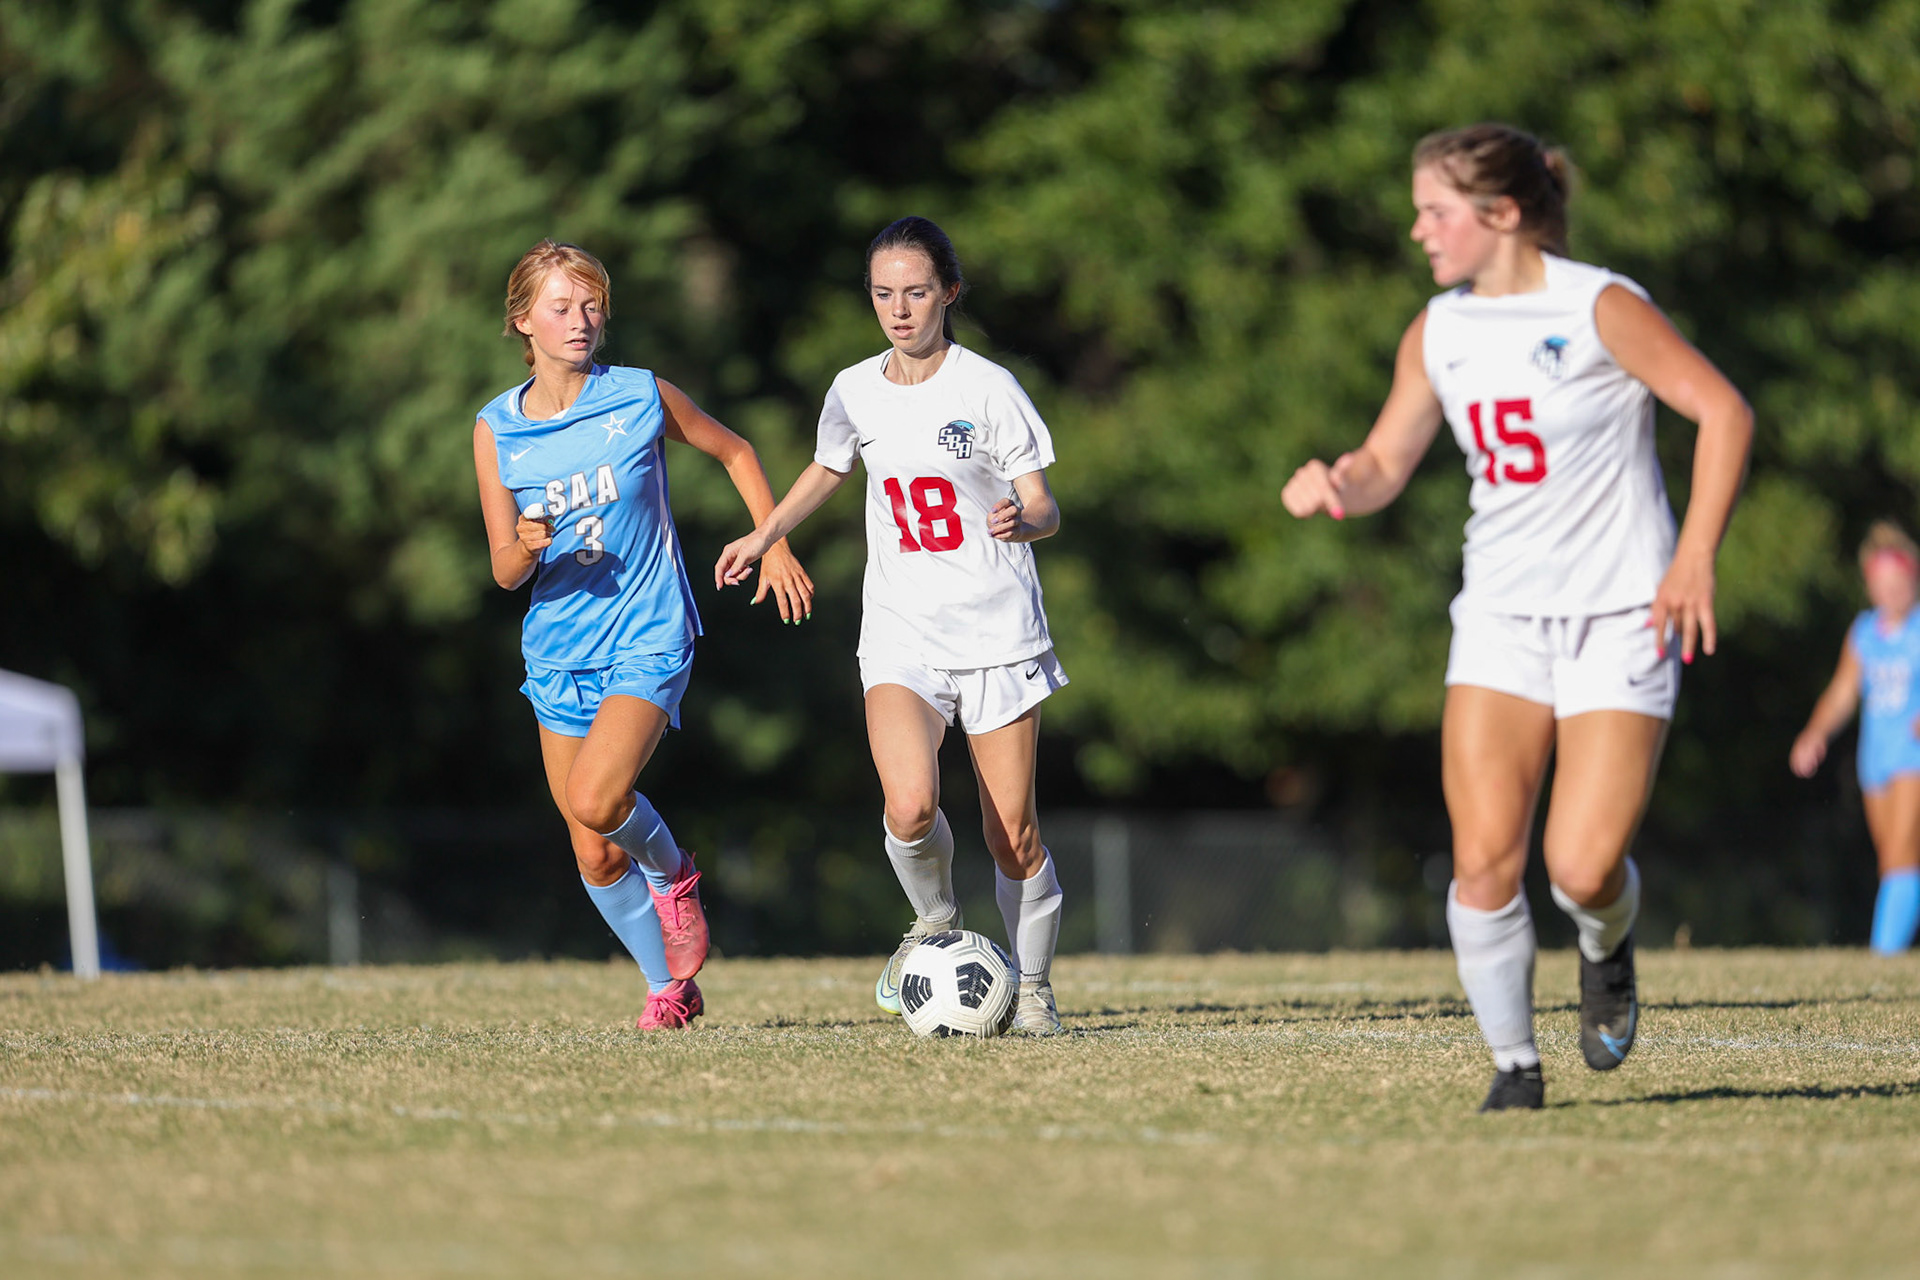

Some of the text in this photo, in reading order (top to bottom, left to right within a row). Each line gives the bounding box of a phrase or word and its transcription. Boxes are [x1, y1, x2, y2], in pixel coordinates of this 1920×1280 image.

[938, 427, 972, 459] SBA
[1468, 398, 1547, 487] 15
[545, 463, 620, 517] SAA
[883, 477, 964, 553] 18
[575, 515, 604, 566] 3
